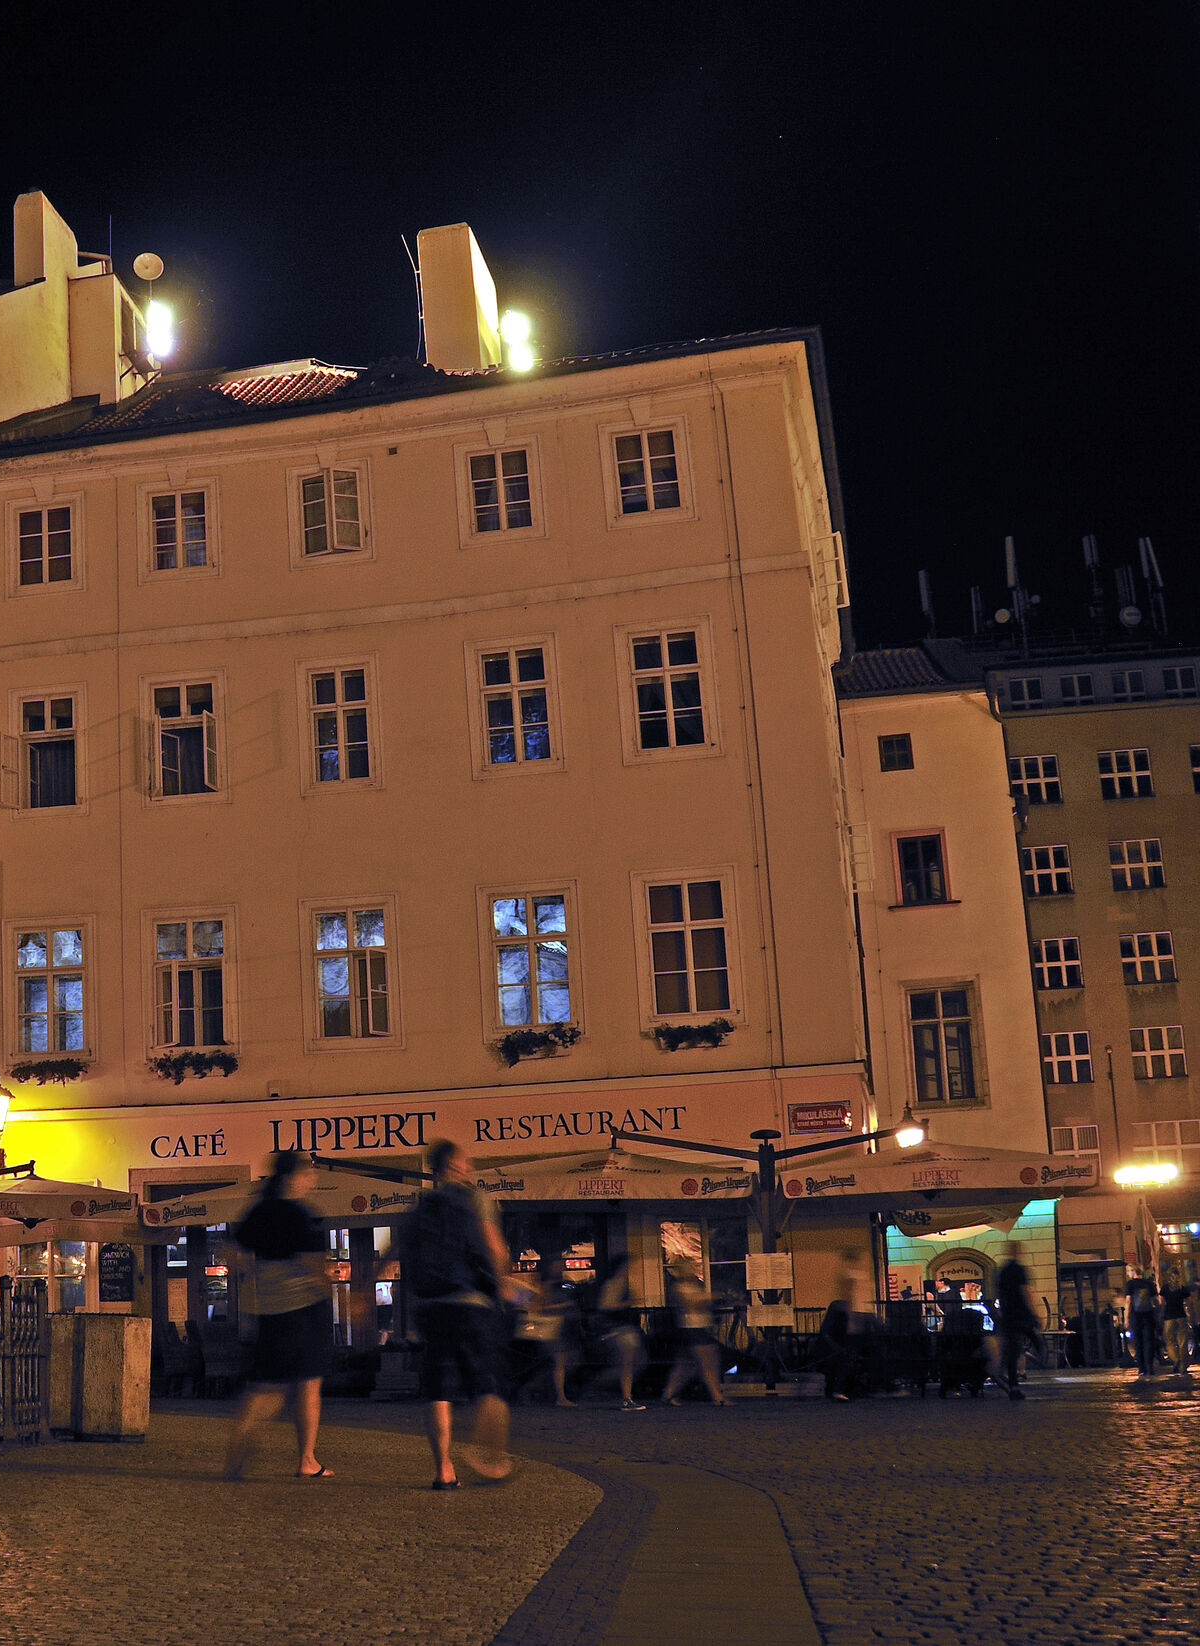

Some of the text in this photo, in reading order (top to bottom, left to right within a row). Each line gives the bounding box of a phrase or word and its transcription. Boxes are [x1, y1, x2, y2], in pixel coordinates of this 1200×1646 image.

[269, 1112, 435, 1153] LIPPERT
[474, 1106, 686, 1142] RESTAURANT
[150, 1129, 227, 1158] CAFÉ
[578, 1180, 626, 1190] LIPPERT
[912, 1170, 962, 1182] LIPPERT
